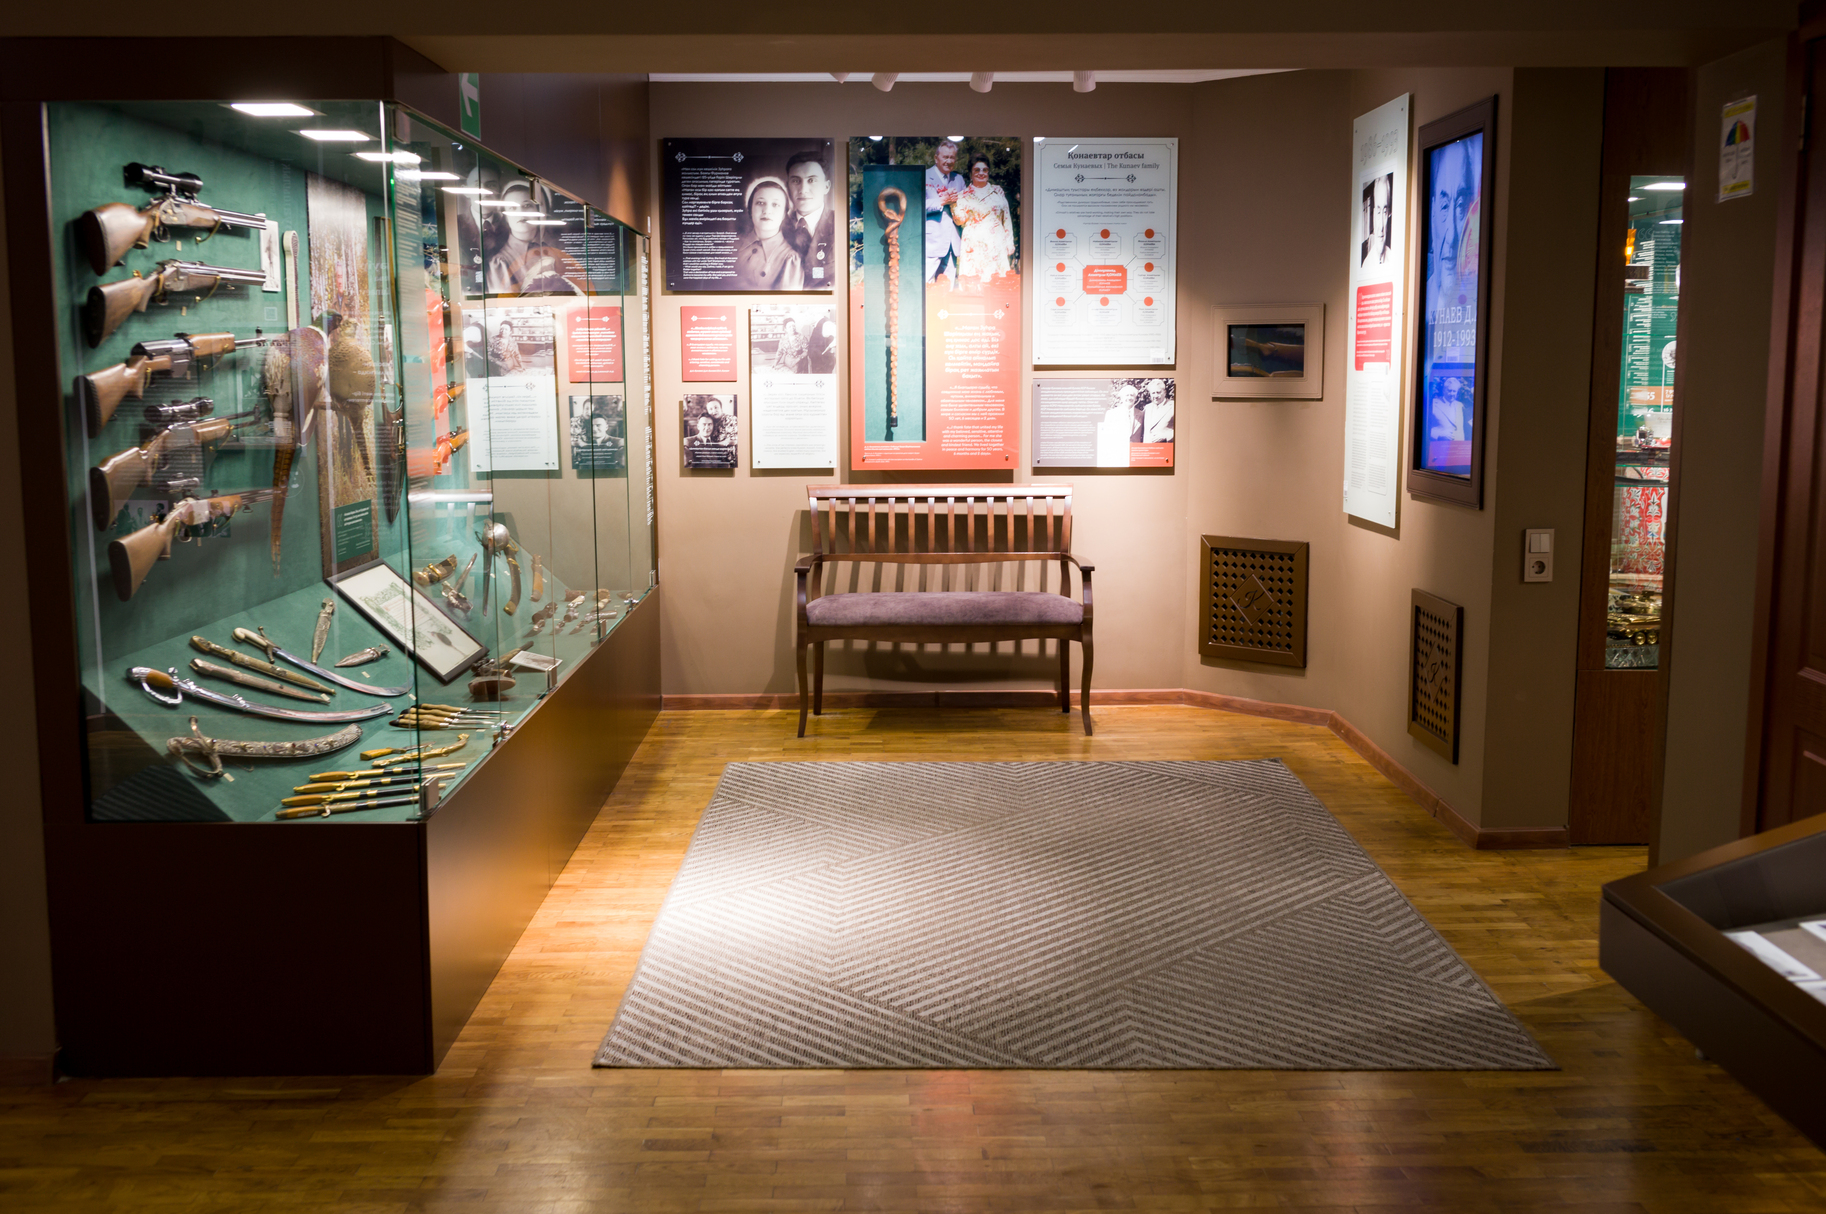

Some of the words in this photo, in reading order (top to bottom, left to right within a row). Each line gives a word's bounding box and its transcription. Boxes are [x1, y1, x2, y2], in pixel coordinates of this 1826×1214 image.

[1068, 152, 1112, 160] Қонаевтар
[1114, 151, 1144, 159] отбасы
[1429, 306, 1462, 325] КУНАЕВ
[1464, 305, 1477, 325] Д.
[1434, 329, 1476, 348] 1912-1993
